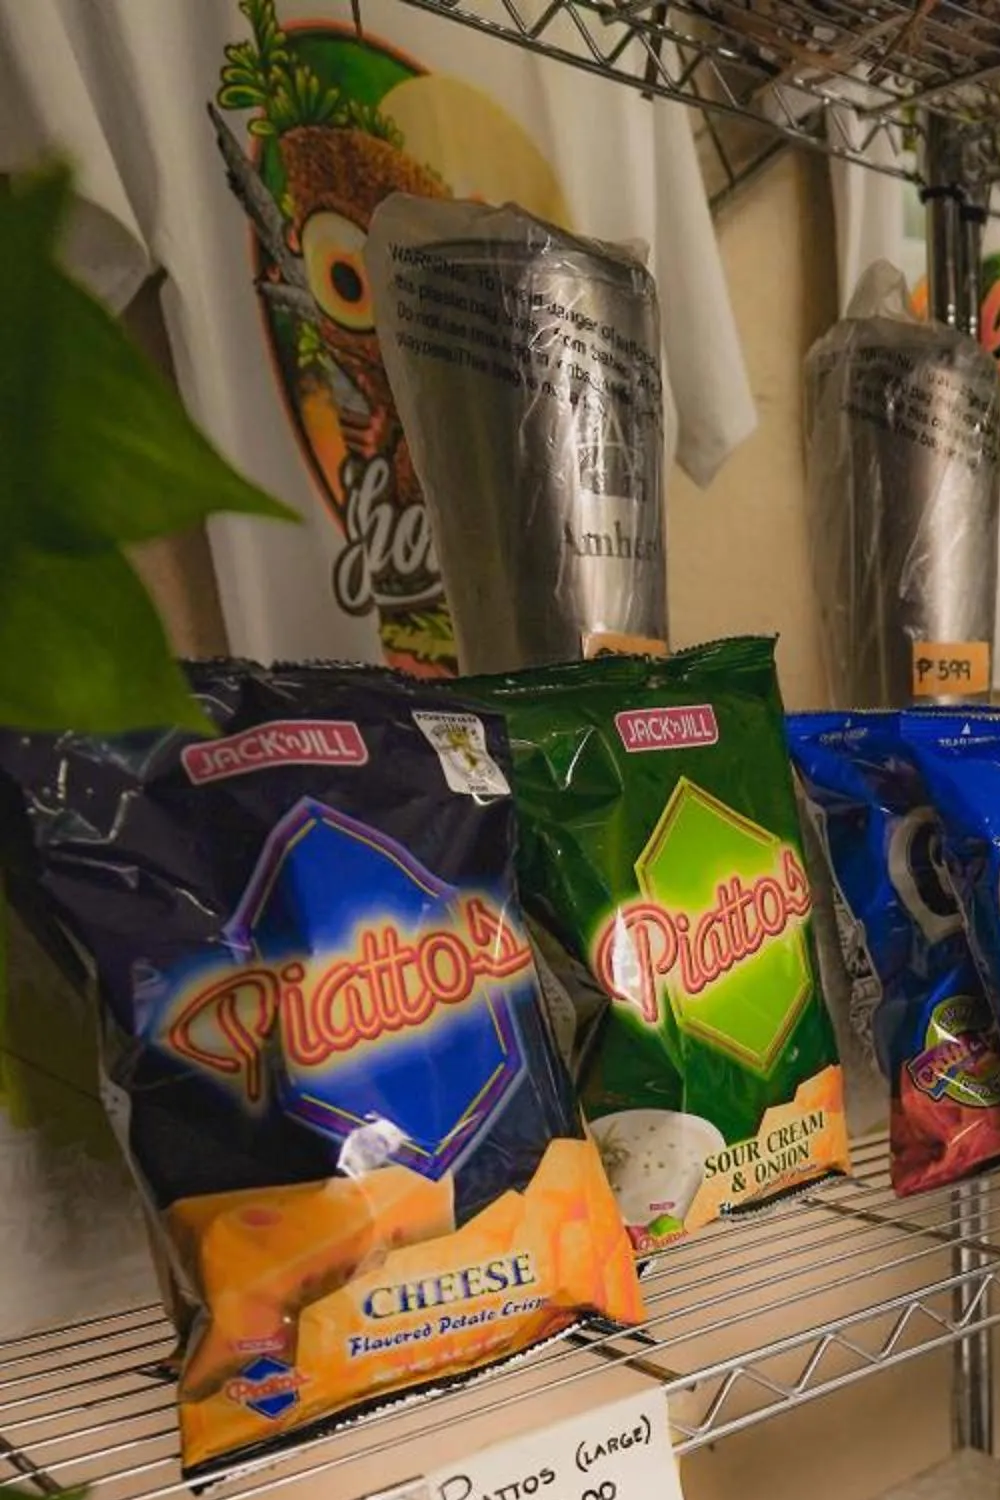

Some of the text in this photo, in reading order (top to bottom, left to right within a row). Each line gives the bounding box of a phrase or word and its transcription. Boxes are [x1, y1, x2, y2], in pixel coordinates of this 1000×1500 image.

[595, 849, 812, 1023] Piattos
[169, 897, 532, 1102] Piattos
[704, 1110, 825, 1179] SOUR CREAM
[731, 1171, 747, 1193] &
[755, 1140, 810, 1184] ONION
[363, 1254, 535, 1319] CHEESE
[349, 1323, 432, 1357] Flavored
[439, 1311, 496, 1334] Potato
[575, 1414, 651, 1473] (LARGE)
